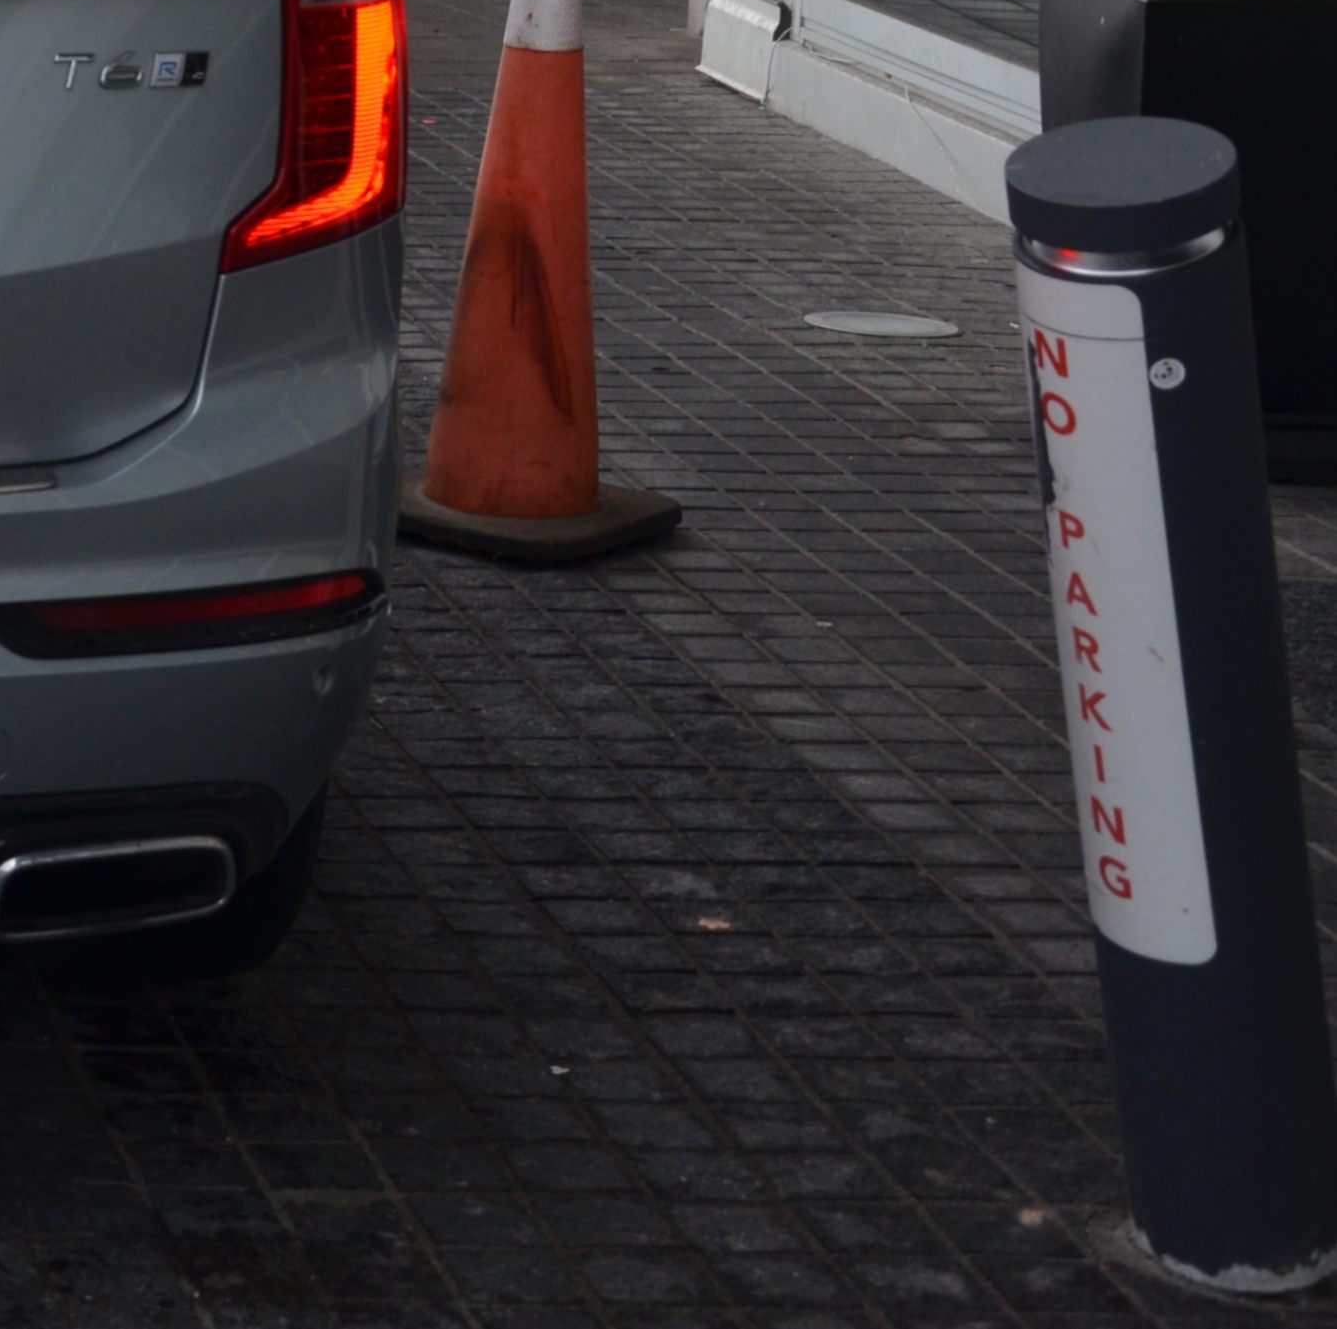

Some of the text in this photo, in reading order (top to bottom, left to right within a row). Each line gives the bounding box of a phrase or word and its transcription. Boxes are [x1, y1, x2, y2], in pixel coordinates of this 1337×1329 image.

[54, 50, 143, 90] T6
[1034, 328, 1077, 436] NO
[1059, 509, 1132, 900] PARKING
